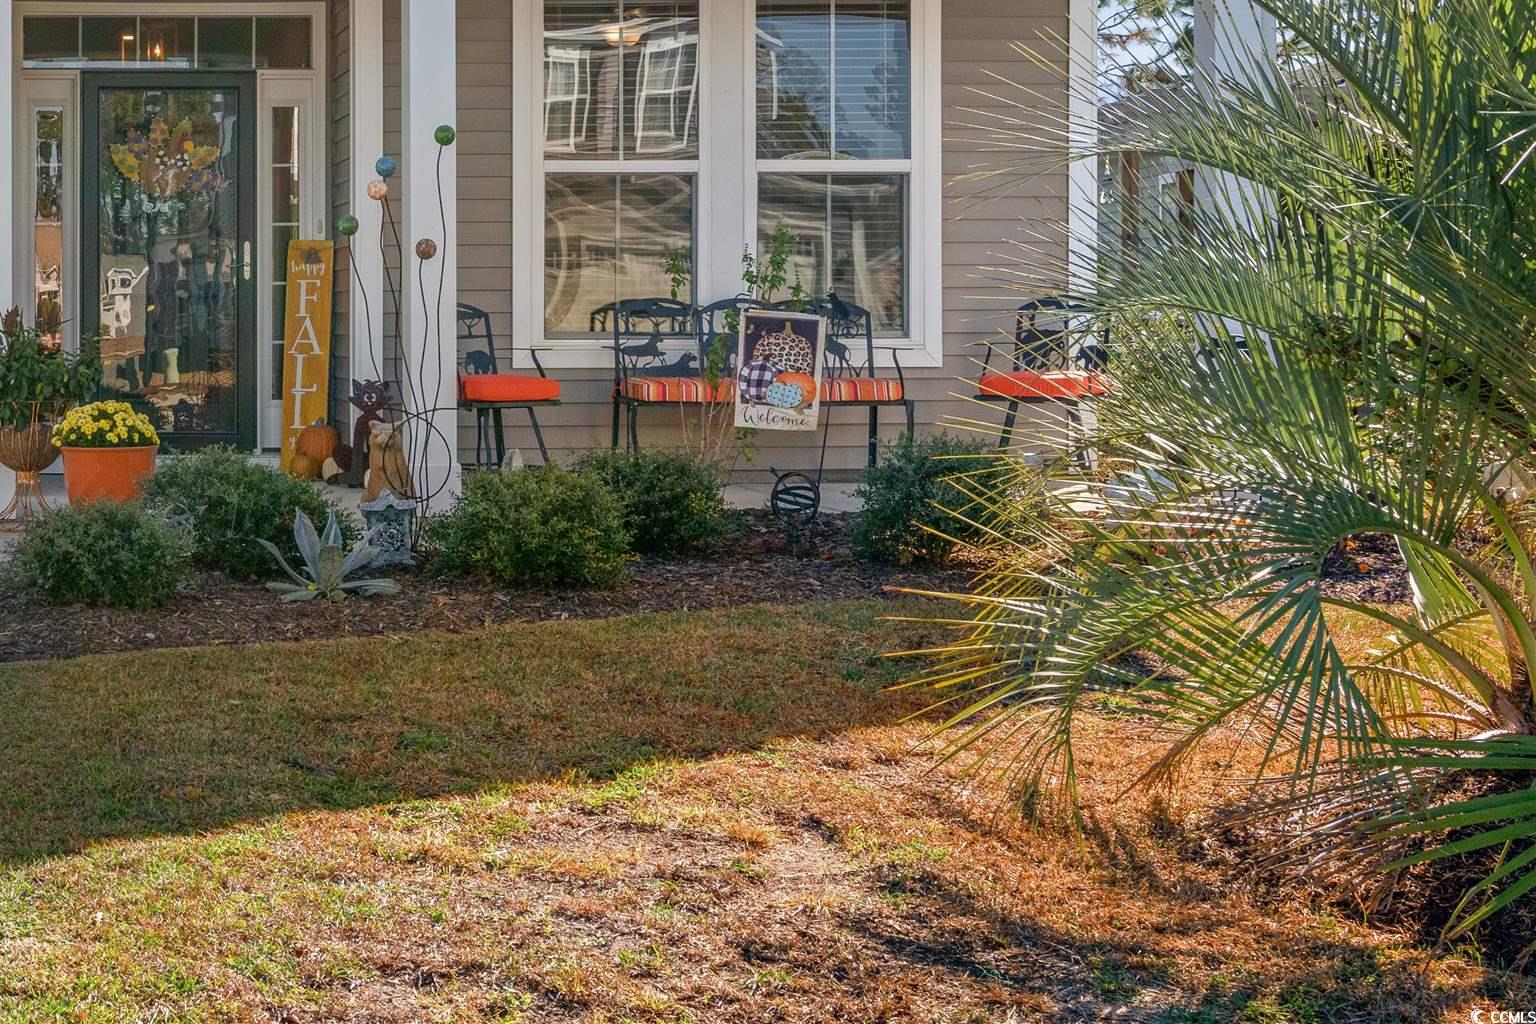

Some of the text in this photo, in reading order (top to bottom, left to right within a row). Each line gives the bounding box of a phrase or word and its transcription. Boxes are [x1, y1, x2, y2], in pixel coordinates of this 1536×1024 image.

[291, 260, 327, 276] happy
[287, 279, 324, 429] FALL
[740, 405, 809, 426] Welcome
